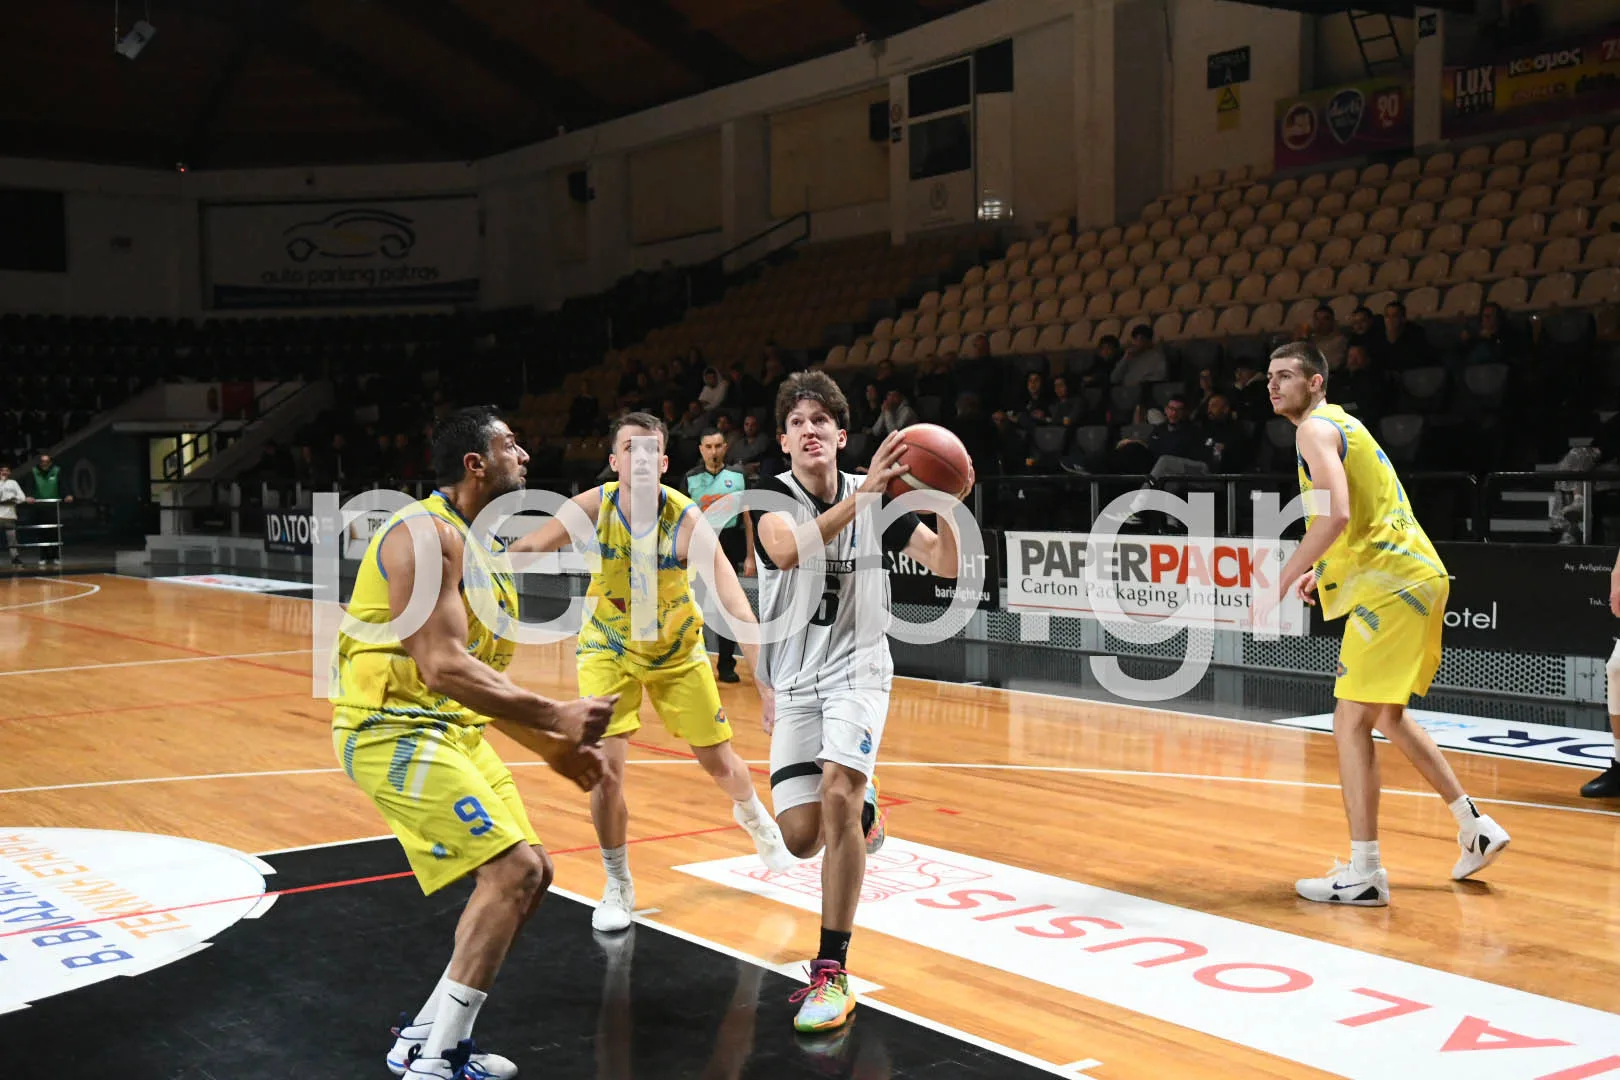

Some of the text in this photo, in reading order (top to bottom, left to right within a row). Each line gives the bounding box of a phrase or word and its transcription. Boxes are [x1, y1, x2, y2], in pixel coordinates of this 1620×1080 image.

[1455, 66, 1493, 97] LUX
[261, 264, 439, 286] auto parking patras
[1020, 540, 1272, 588] PAPERPACK
[1020, 577, 1251, 609] Carton Packaging Indust
[1443, 601, 1497, 630] otel
[453, 796, 493, 836] 9
[916, 887, 1620, 1080] ALOUSIS
